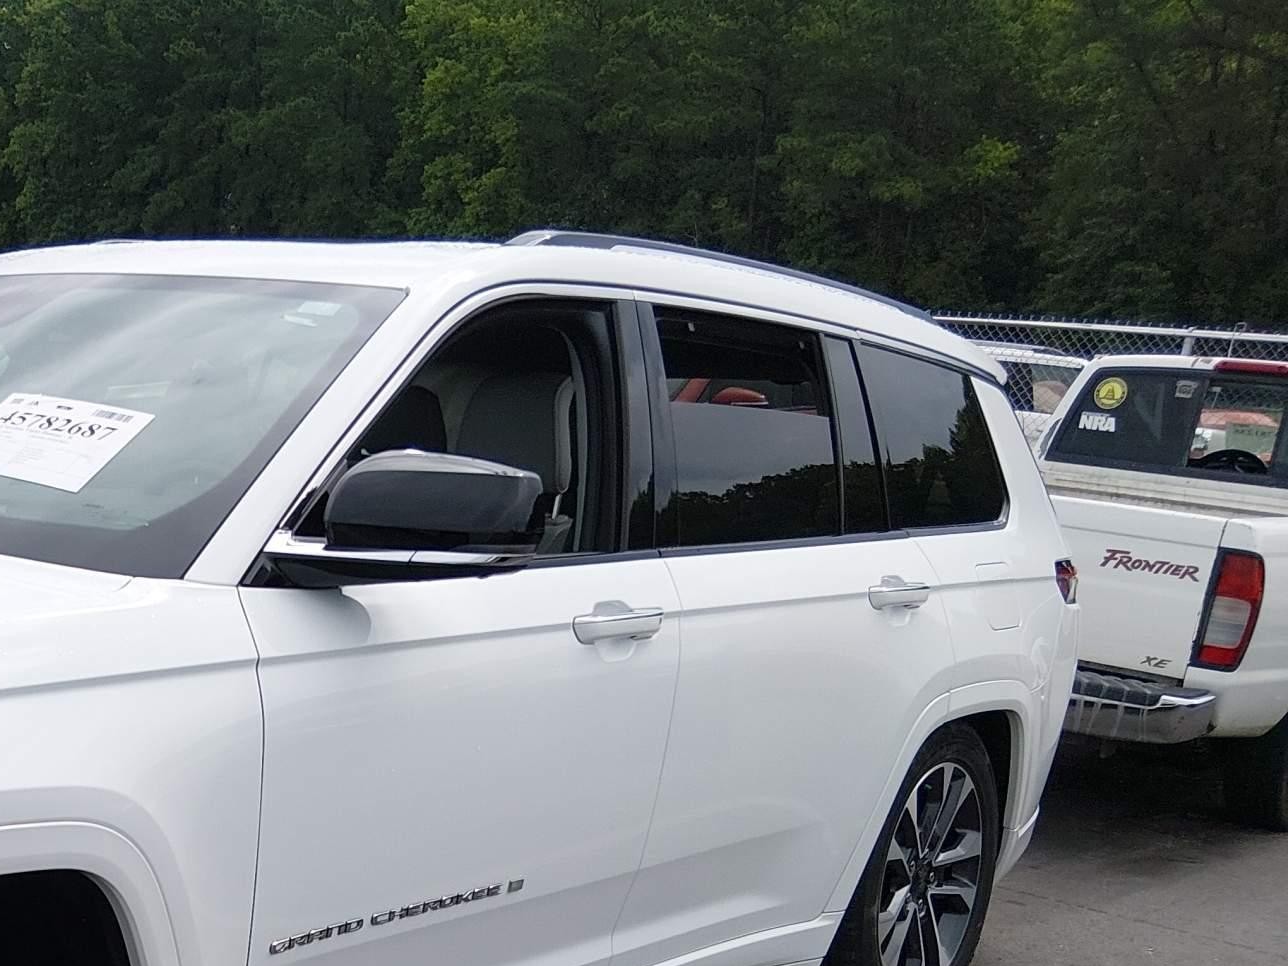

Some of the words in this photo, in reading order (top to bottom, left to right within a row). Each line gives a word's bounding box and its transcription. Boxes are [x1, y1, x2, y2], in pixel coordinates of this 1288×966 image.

[0, 410, 119, 441] 45782687
[1078, 414, 1116, 433] NRA
[1140, 655, 1173, 669] XE
[268, 917, 364, 955] GRAND
[370, 883, 503, 927] CHEROKEE
